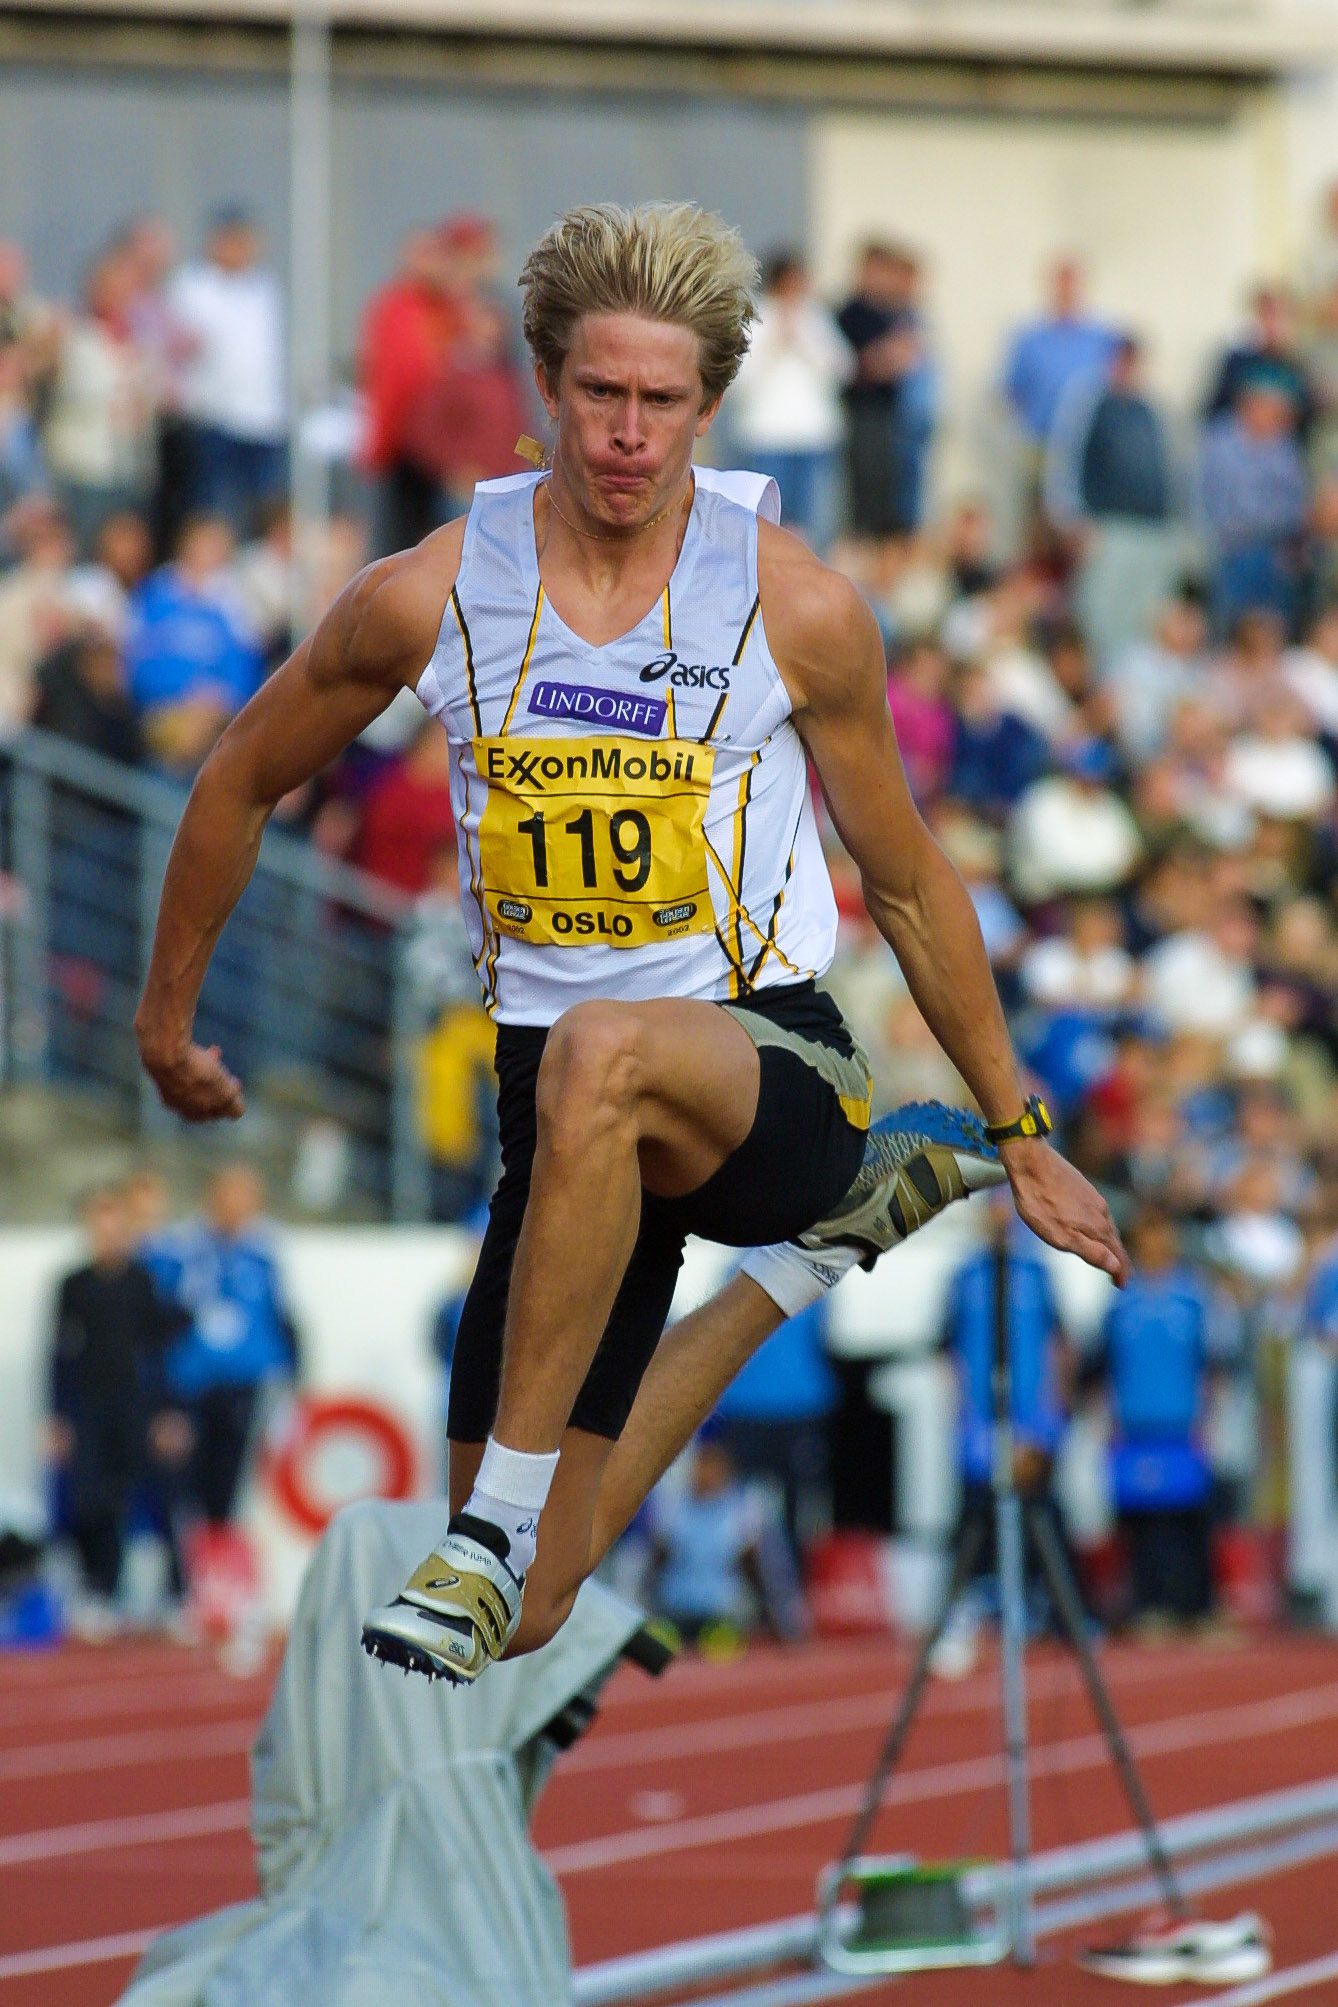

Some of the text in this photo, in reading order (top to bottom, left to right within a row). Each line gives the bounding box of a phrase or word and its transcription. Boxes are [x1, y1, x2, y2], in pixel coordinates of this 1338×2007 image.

[536, 686, 659, 725] LINDORFF
[488, 747, 694, 790] ExxonMobil
[517, 809, 652, 893] 119
[552, 911, 633, 936] OSLO
